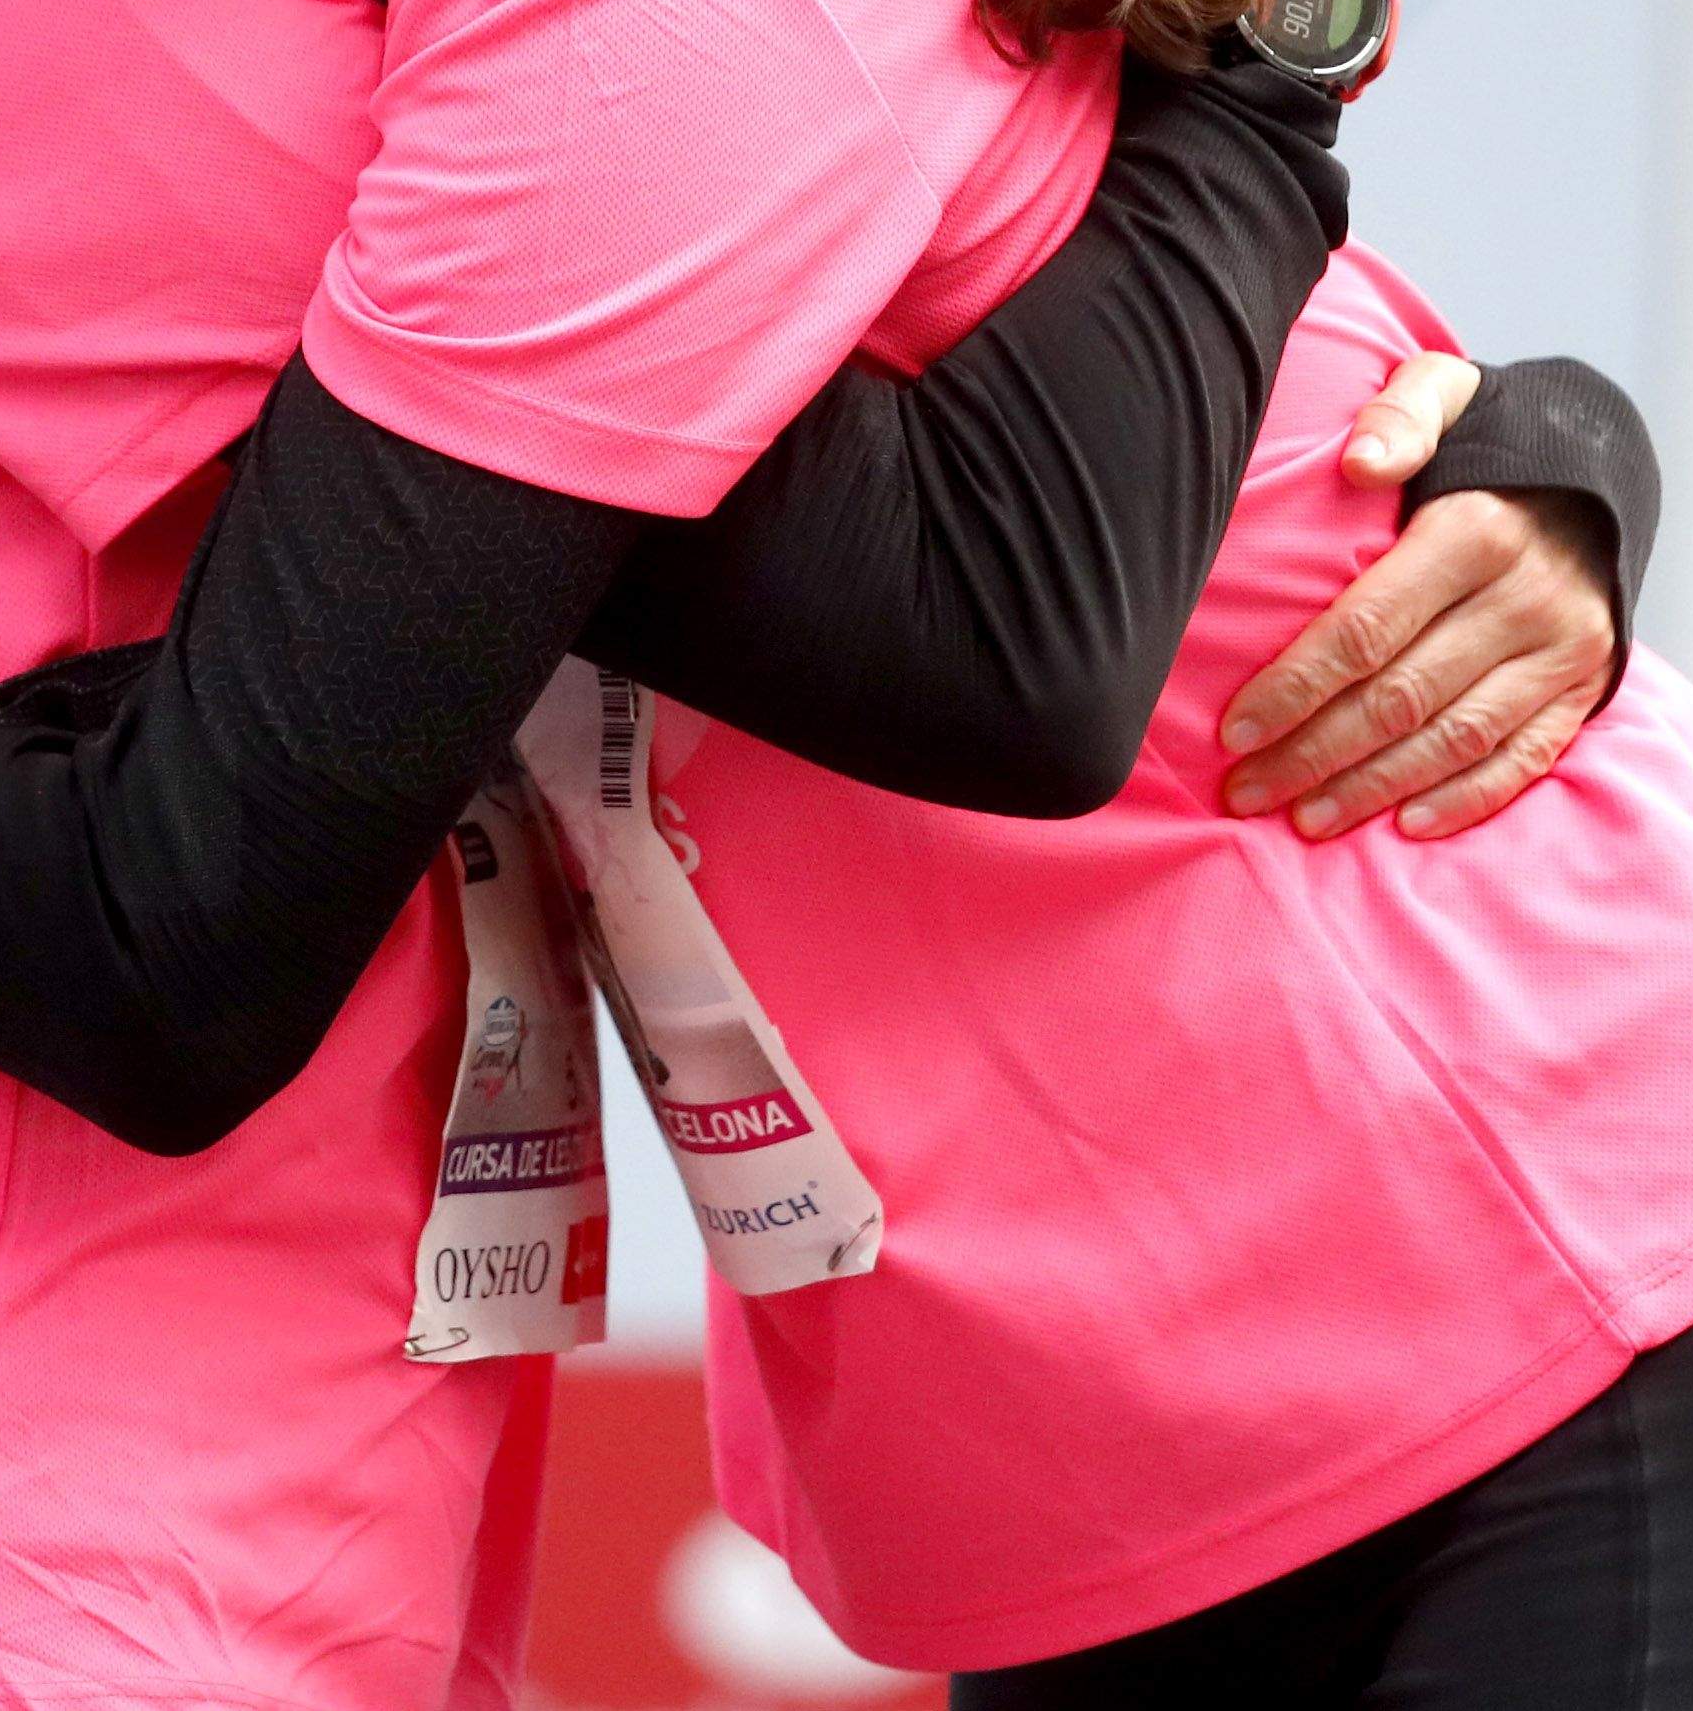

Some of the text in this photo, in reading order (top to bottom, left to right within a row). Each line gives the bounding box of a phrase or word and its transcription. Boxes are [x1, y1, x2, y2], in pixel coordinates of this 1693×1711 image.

[447, 1142, 513, 1183] CURSA
[517, 1140, 546, 1178] DE
[434, 1240, 551, 1303] OYSHO
